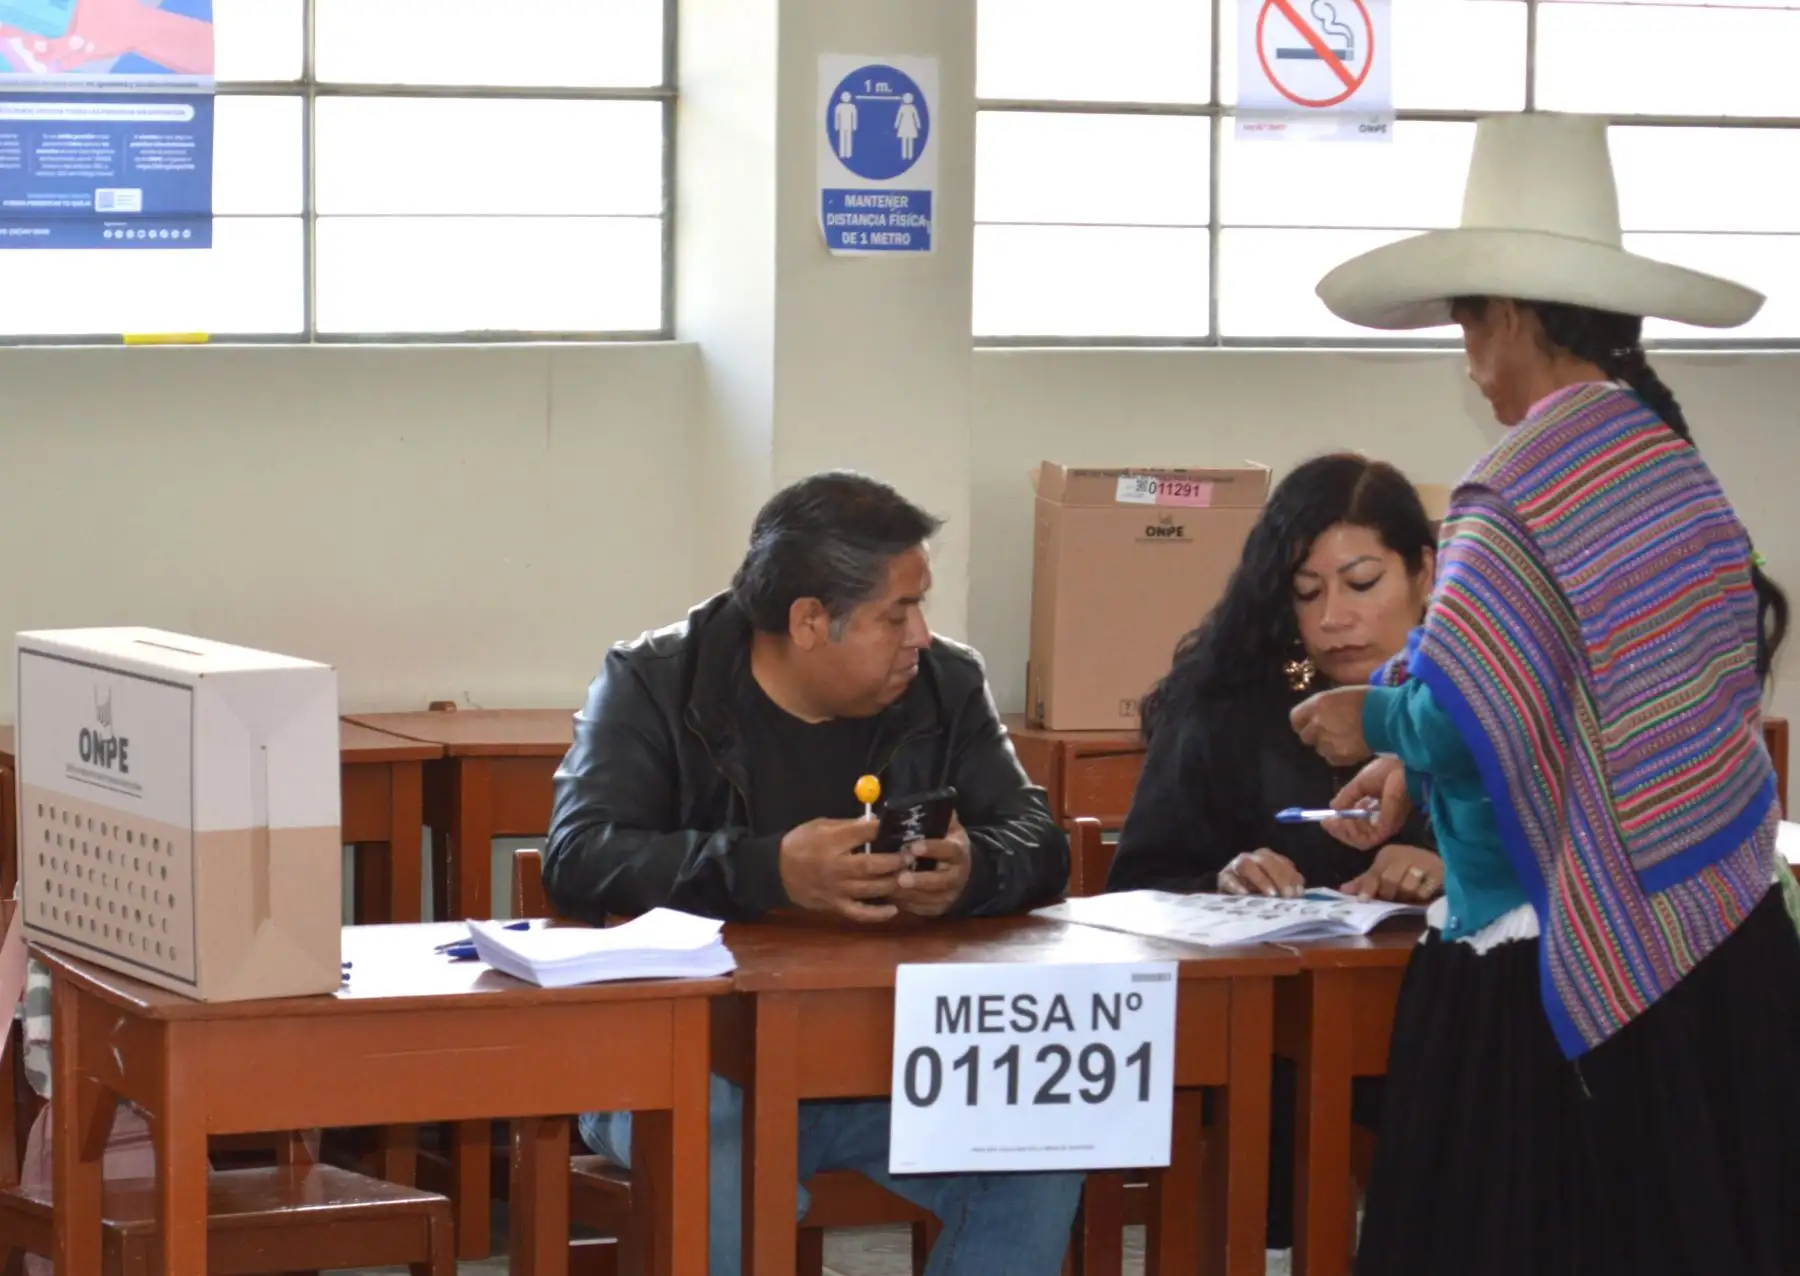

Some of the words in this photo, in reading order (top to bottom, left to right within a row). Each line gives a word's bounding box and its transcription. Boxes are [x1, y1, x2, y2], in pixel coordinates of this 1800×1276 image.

[864, 79, 871, 93] 1
[875, 82, 893, 93] m.
[844, 195, 909, 208] MANTENER
[826, 213, 886, 227] DISTANCIA
[841, 232, 857, 245] DE
[860, 232, 868, 245] 1
[871, 232, 911, 245] METRO
[1148, 481, 1199, 497] 011291
[1145, 525, 1184, 537] ONPE
[79, 728, 129, 773] ONPE
[935, 993, 1075, 1034] MESA
[904, 1041, 1152, 1108] 011291
